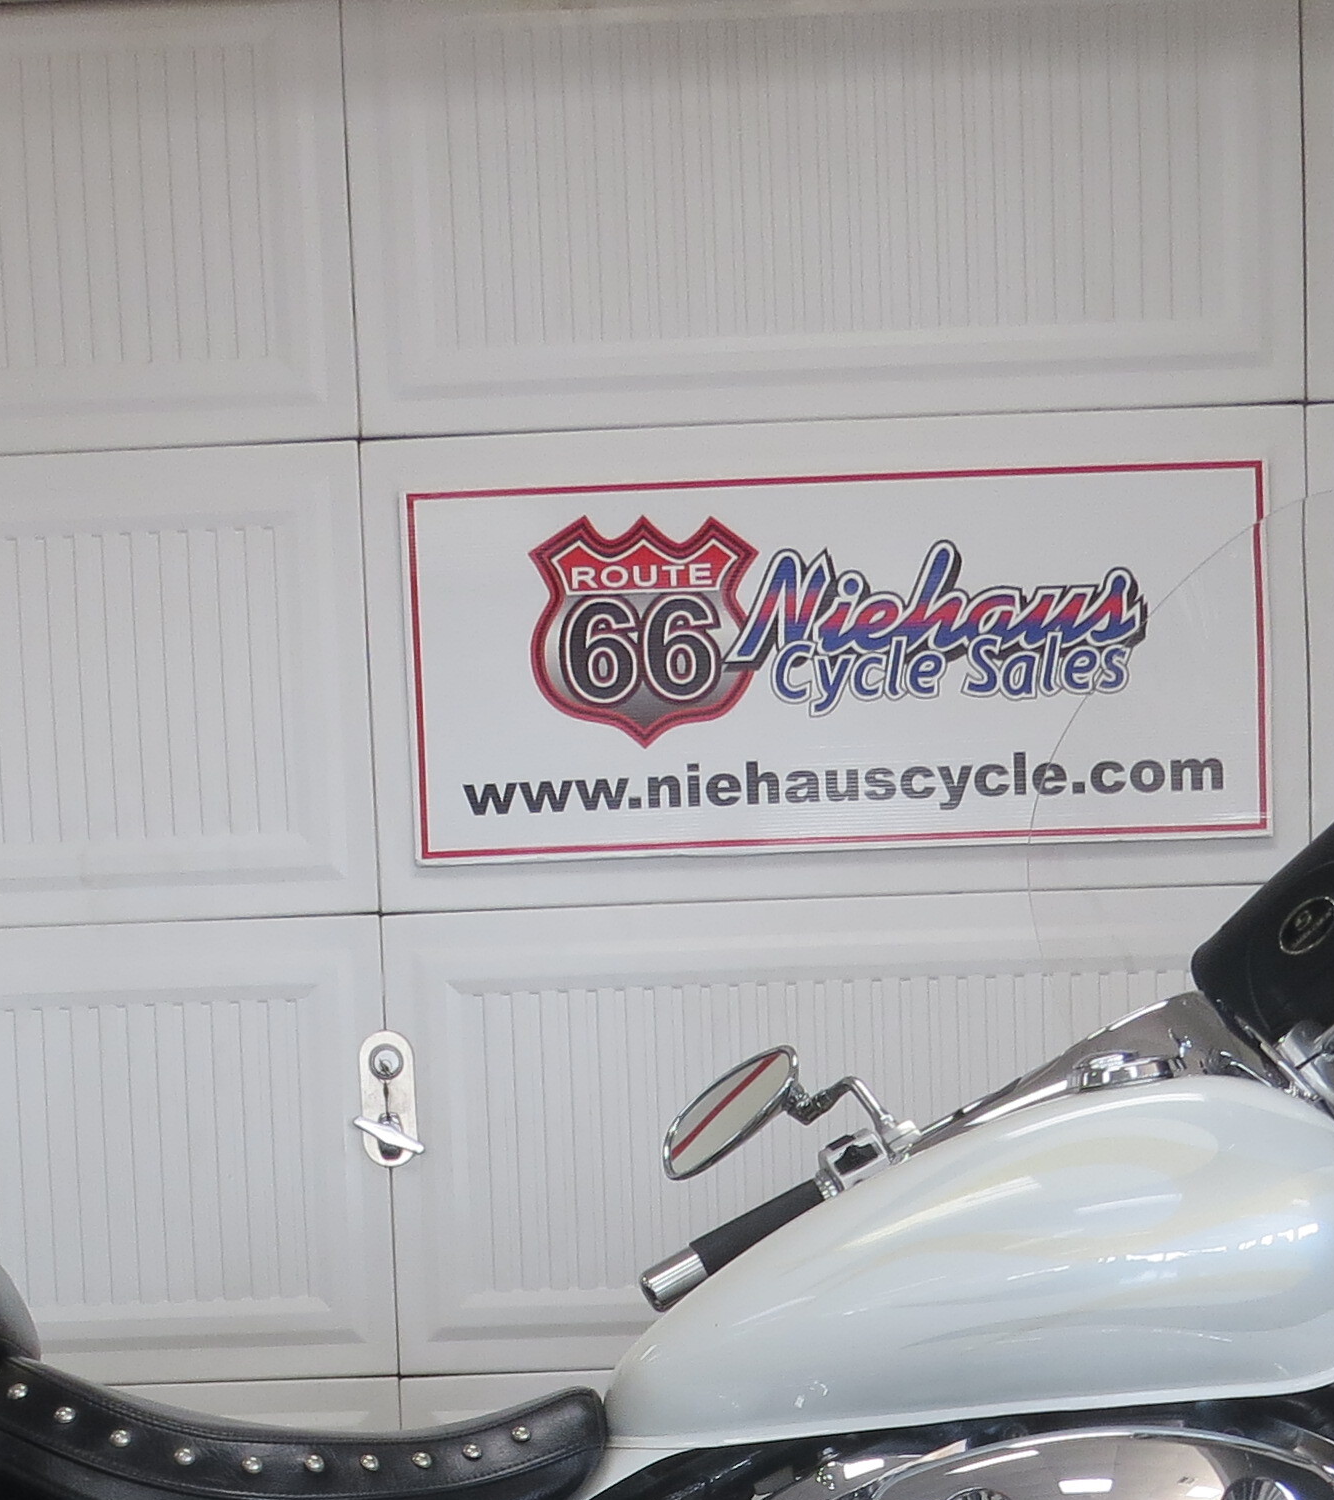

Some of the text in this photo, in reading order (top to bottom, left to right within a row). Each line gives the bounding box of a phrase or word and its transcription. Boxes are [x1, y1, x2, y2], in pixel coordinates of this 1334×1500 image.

[570, 562, 713, 590] ROUTE
[725, 540, 1146, 672] Niehaus
[560, 592, 722, 707] 66
[770, 632, 1131, 718] Cycle Sales
[462, 752, 1226, 817] www.niehauscycle.com
